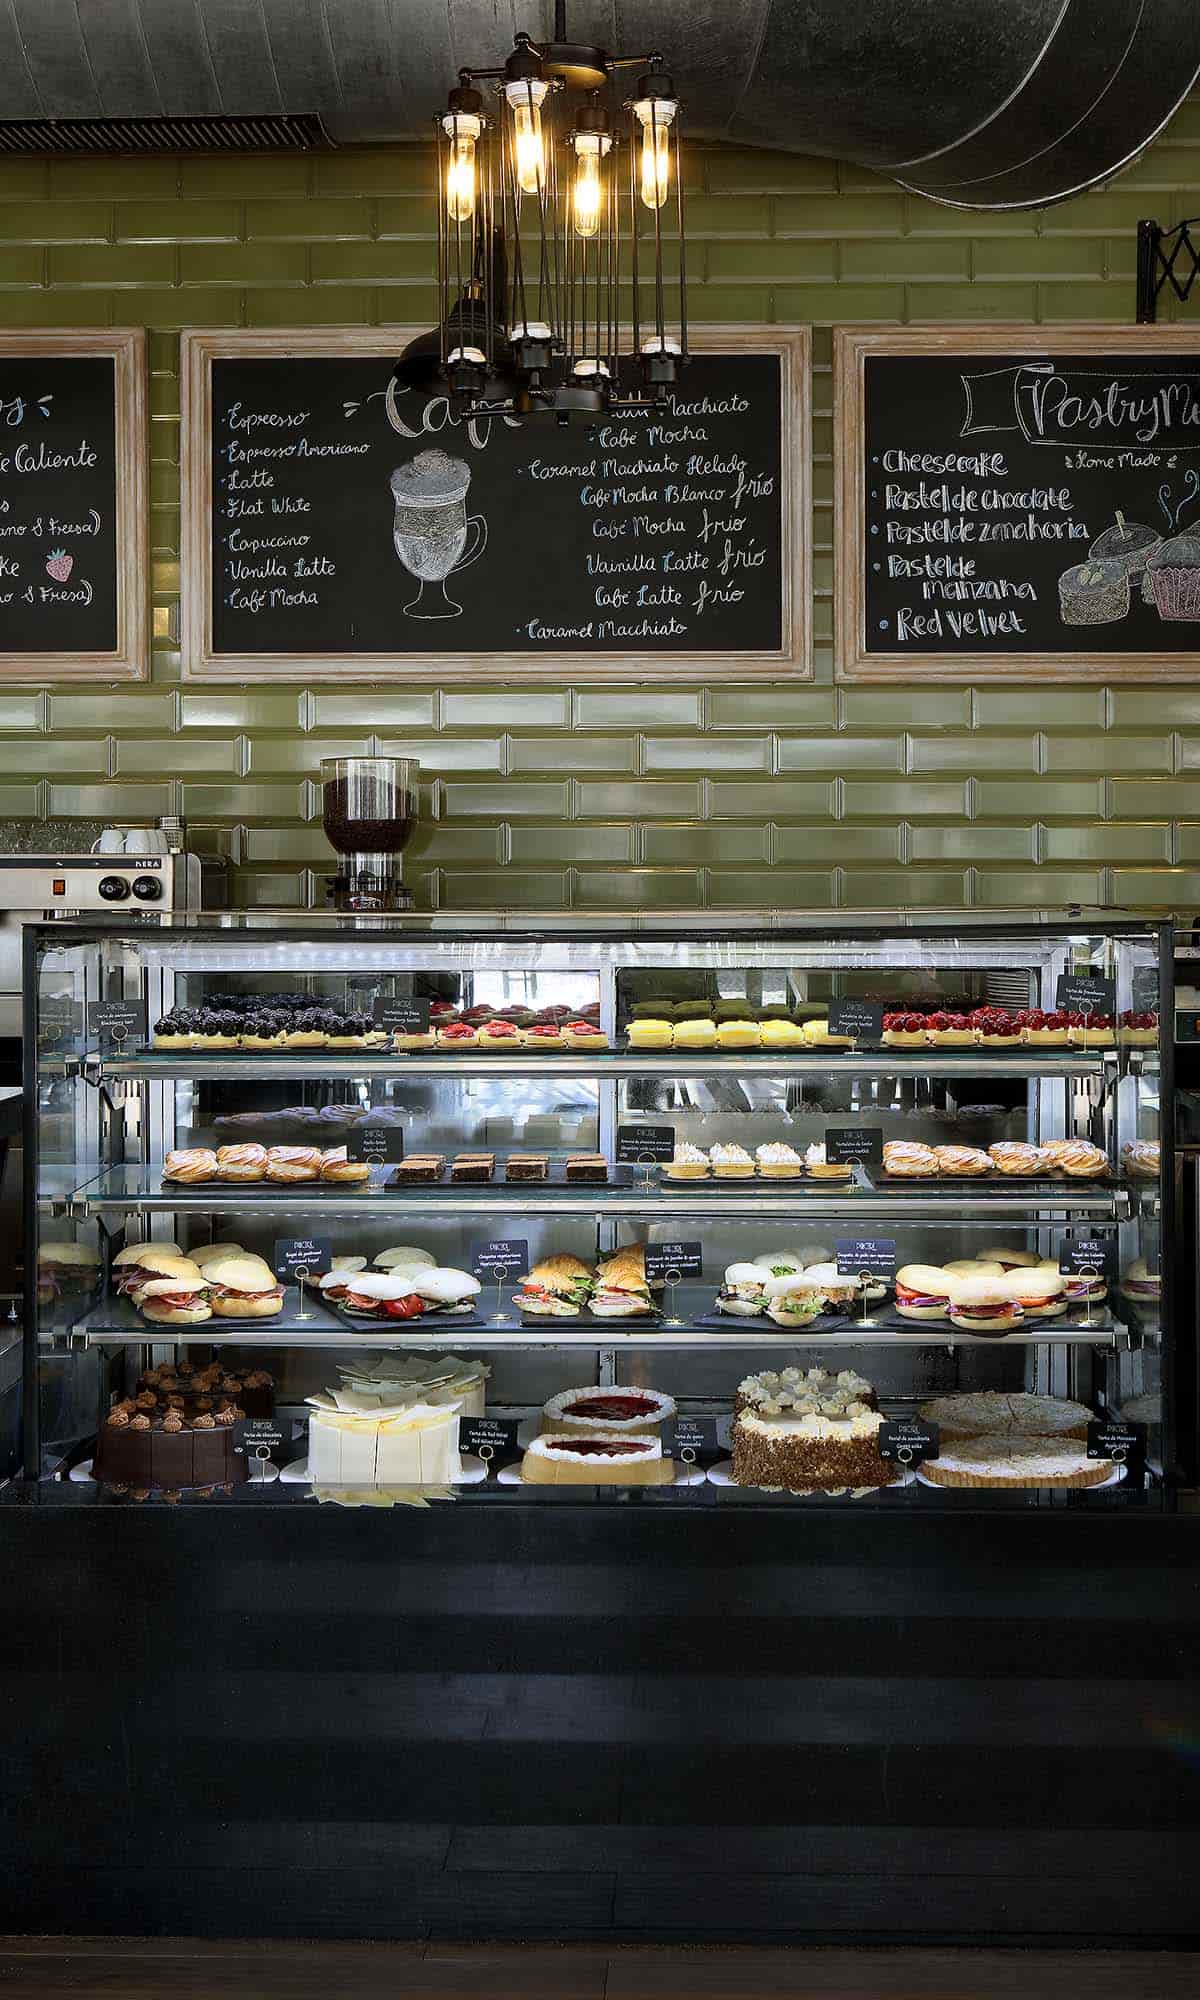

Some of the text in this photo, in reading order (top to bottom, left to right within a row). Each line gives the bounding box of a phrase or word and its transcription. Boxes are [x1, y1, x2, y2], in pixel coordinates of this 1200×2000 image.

[228, 402, 310, 435] Espresso
[649, 425, 709, 444] Mocha
[15, 440, 97, 473] Caliente
[527, 459, 597, 480] Caramel
[601, 453, 680, 478] Macchiato
[227, 469, 275, 490] Latte
[612, 486, 658, 505] Mocha
[664, 485, 727, 504] Blanco
[226, 498, 311, 518] Flat White
[632, 515, 686, 537] Mocha
[293, 556, 337, 577] Latte
[662, 550, 710, 573] Latte
[269, 588, 319, 608] Mocha
[635, 584, 683, 606] Latte
[525, 616, 688, 640] Caramel Macchiato
[897, 607, 944, 641] Red
